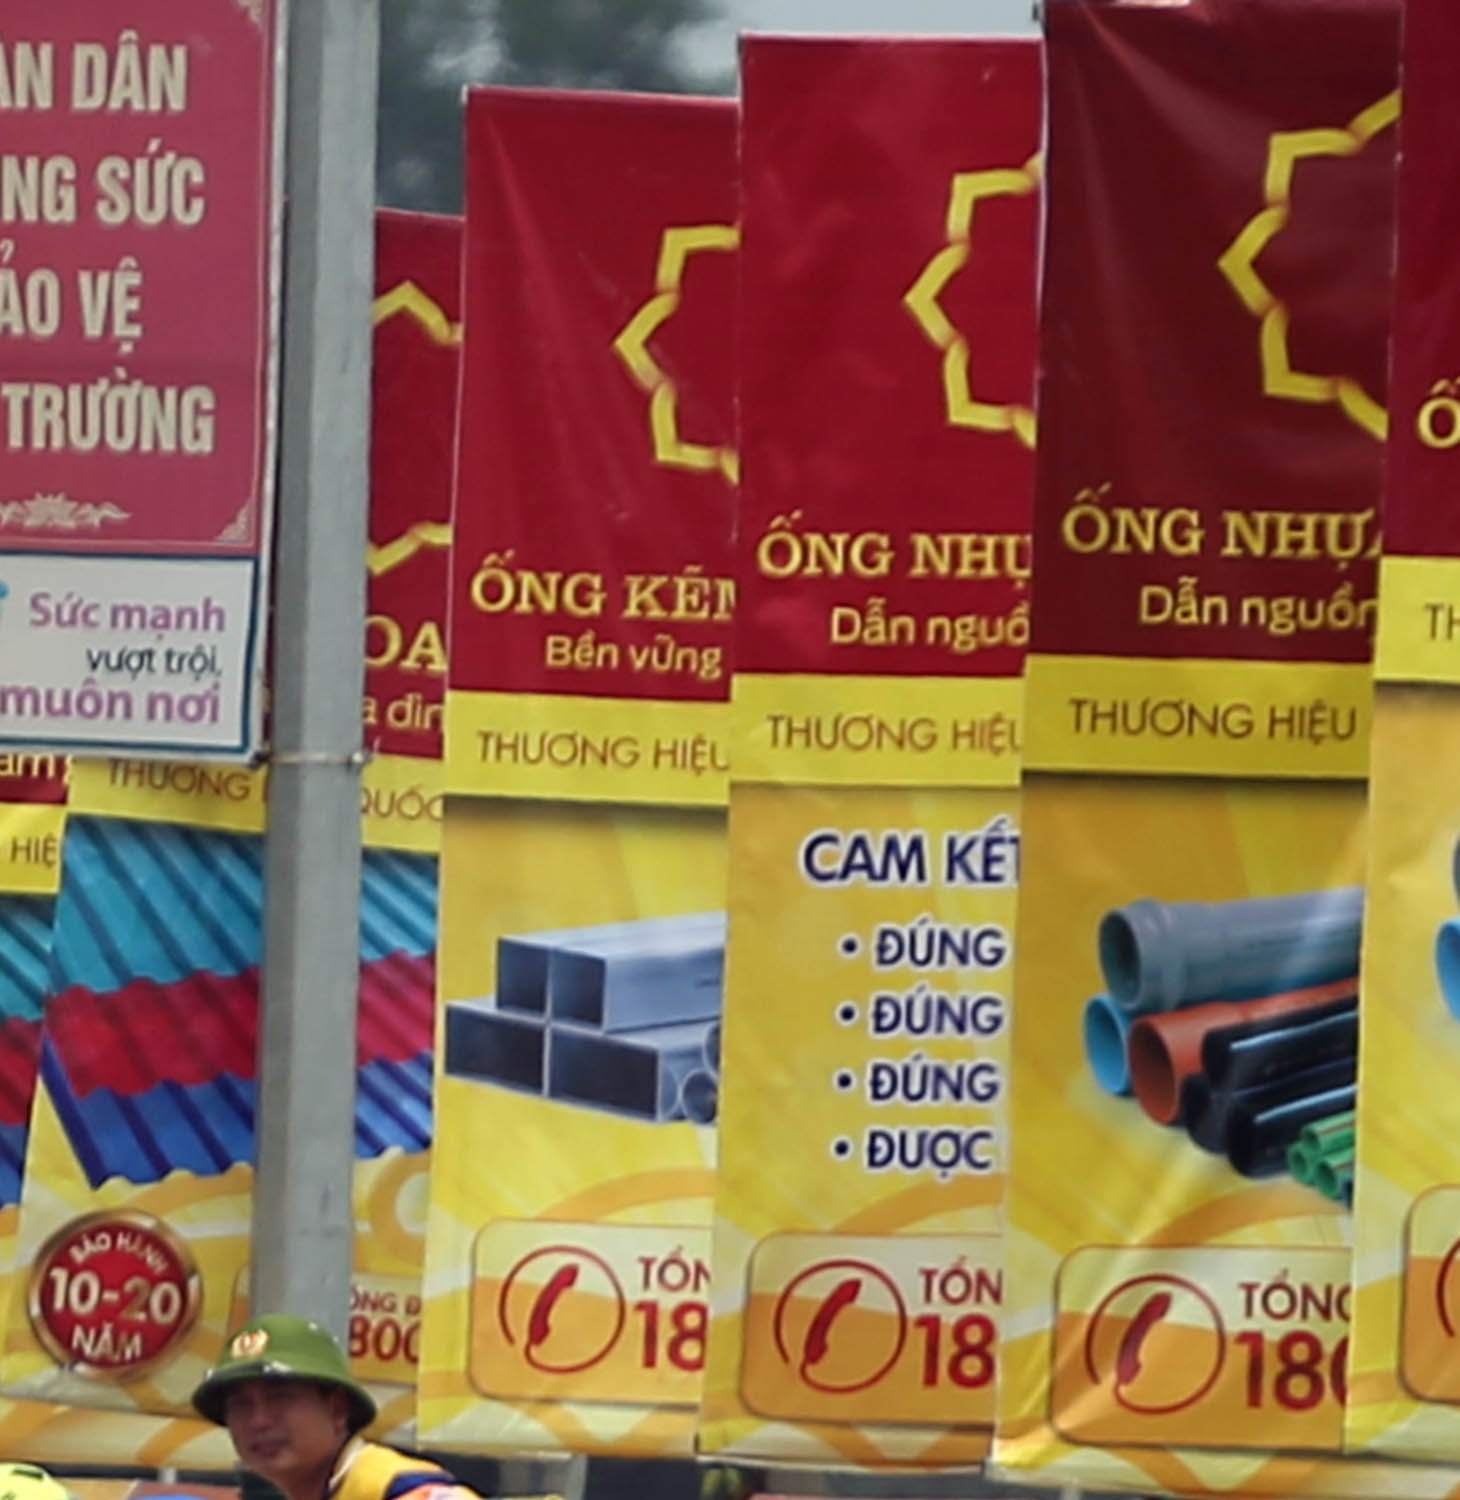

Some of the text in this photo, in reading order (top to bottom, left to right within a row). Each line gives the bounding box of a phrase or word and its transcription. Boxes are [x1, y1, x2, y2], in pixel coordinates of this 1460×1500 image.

[71, 31, 187, 113] DÂN
[96, 140, 205, 225] SỨC
[78, 257, 144, 355] VỆ
[2, 367, 217, 454] TRƯỜNG
[758, 511, 894, 579] ỐNG
[1063, 482, 1382, 572] ỐNG NHỰ
[471, 549, 606, 619] ỐNG
[1140, 577, 1228, 627] Dẫn
[31, 588, 227, 643] Sức mạnh
[830, 598, 915, 646] Dẫn
[86, 645, 157, 678] vượt
[546, 630, 723, 682] Bền vững
[148, 680, 221, 725] nơi
[1069, 697, 1357, 746] THƯƠNG HIỆU
[480, 729, 640, 769] THƯƠNG
[767, 714, 937, 755] THƯƠNG
[803, 831, 927, 884] CAM
[876, 918, 1006, 968] ĐÚNG
[871, 985, 1003, 1036] ĐÚNG
[869, 1053, 1000, 1104] ĐÚNG
[49, 1266, 181, 1326] 10-20
[71, 1322, 143, 1363] NĂM
